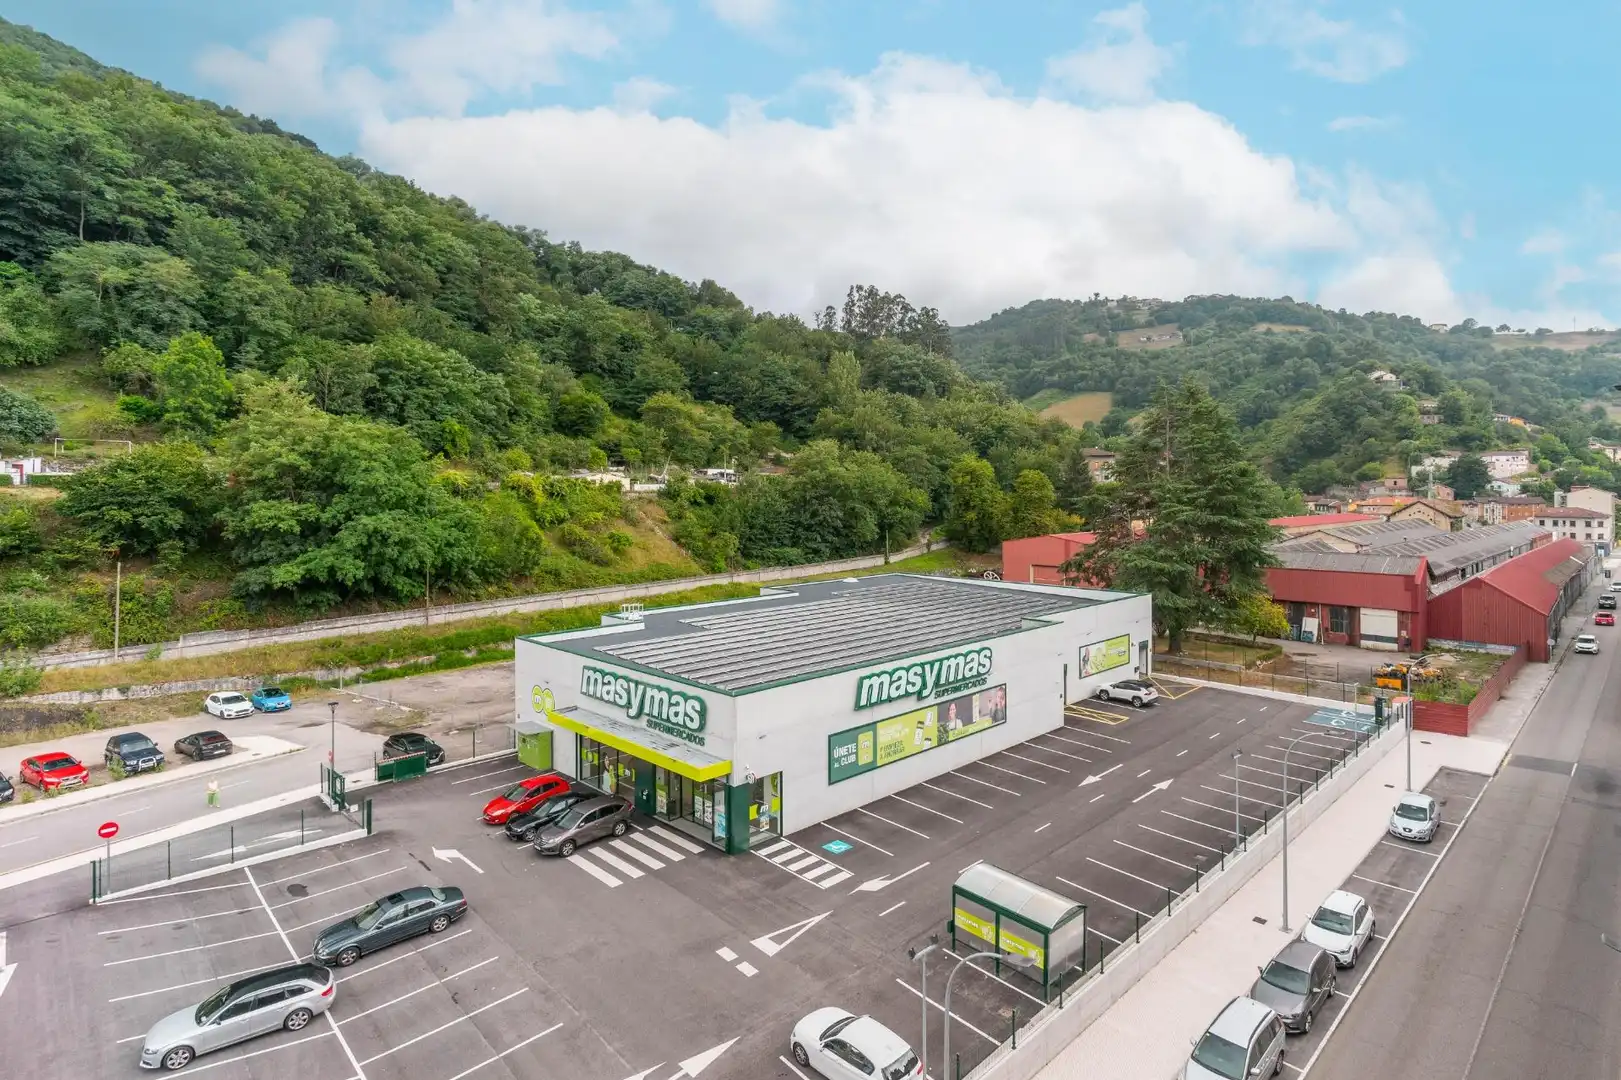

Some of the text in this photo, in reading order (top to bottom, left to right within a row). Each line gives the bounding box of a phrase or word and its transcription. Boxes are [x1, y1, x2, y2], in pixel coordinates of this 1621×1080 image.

[859, 648, 992, 706] masymas
[935, 677, 988, 699] SUPERMERCADOS
[581, 668, 702, 730] masymas
[646, 719, 706, 747] SUPERMERCADOS
[833, 743, 857, 758] ÚNETE
[841, 755, 857, 766] CLUB
